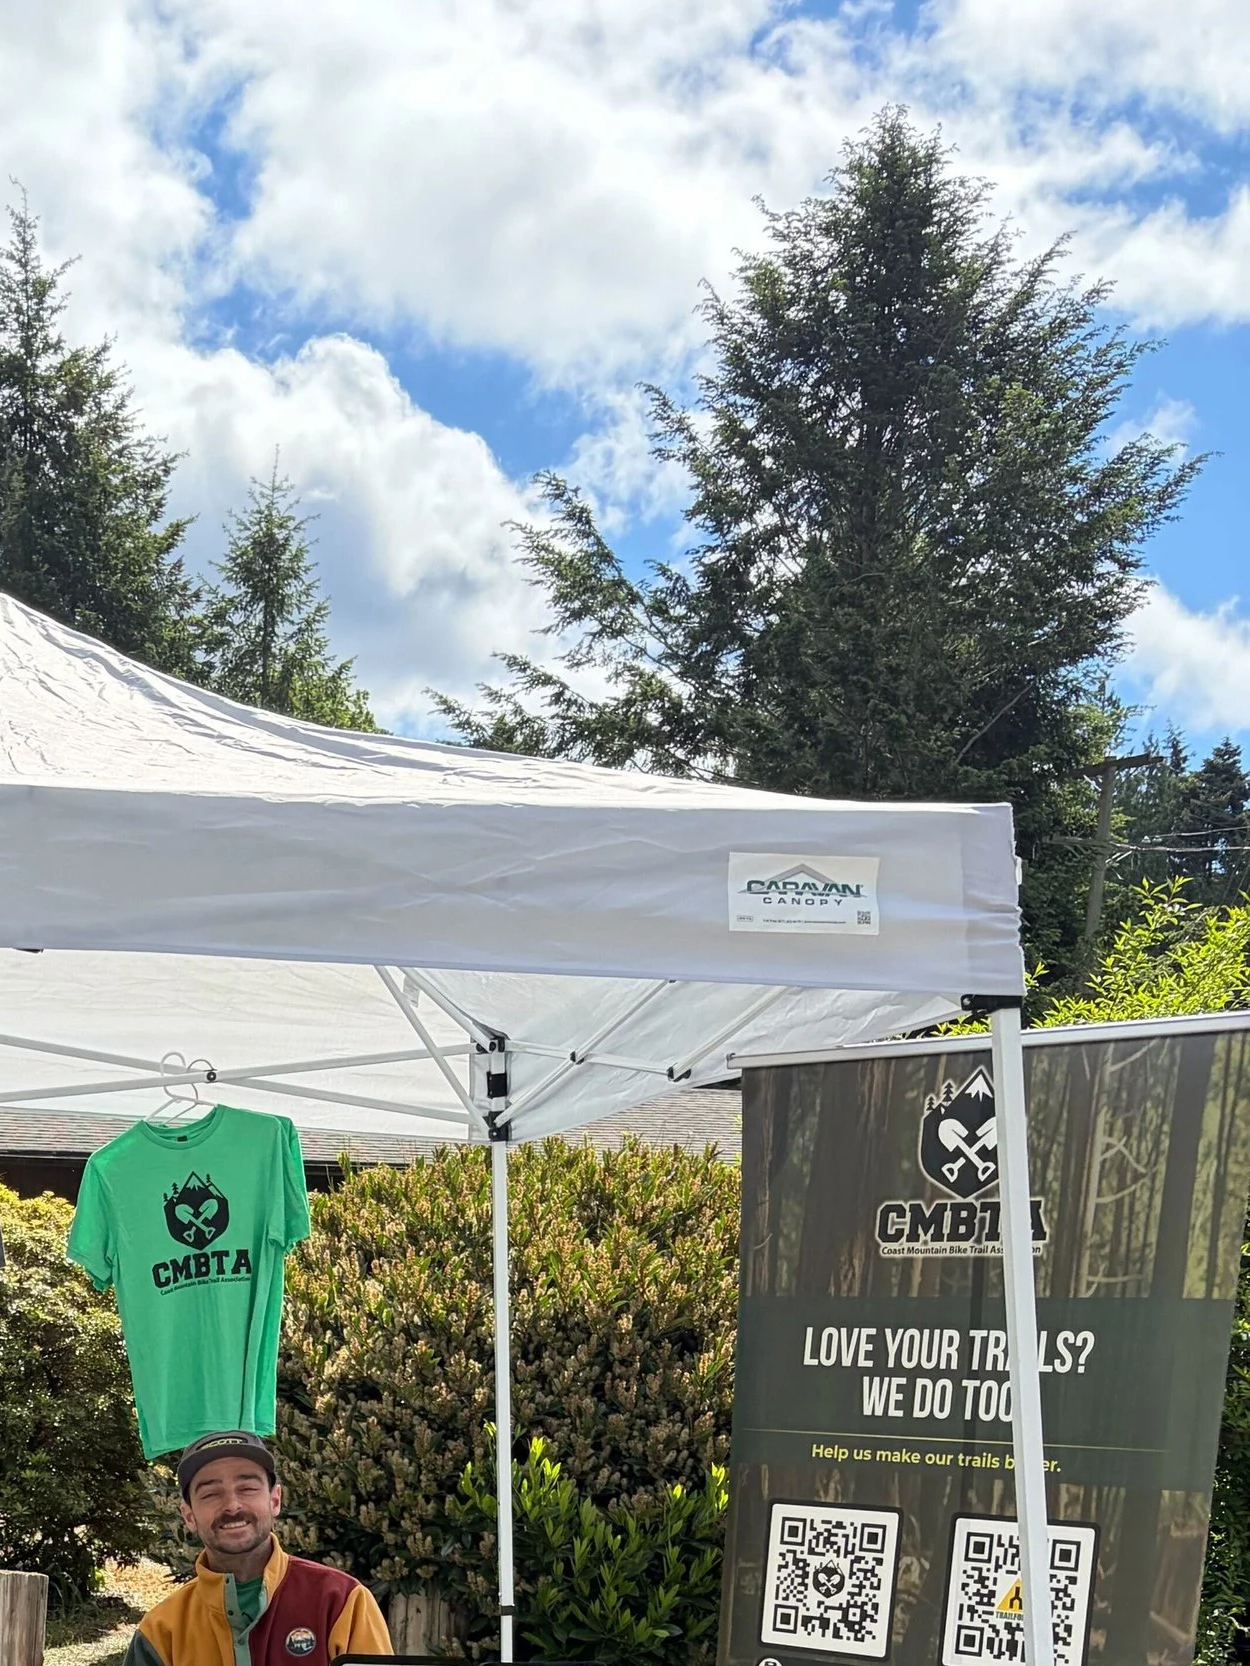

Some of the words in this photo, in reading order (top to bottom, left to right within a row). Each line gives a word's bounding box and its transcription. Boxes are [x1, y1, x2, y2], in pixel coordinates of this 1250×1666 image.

[746, 879, 862, 898] CARAVAN
[763, 897, 843, 906] CANOPY
[881, 1246, 905, 1255] Coast
[906, 1246, 947, 1255] Mountain
[949, 1245, 968, 1254] Bike
[969, 1245, 989, 1254] Trail
[151, 1249, 252, 1289] CMBTA
[803, 1327, 877, 1368] LOVE
[885, 1328, 960, 1371] YOUR
[969, 1329, 1095, 1374] TRLS?
[862, 1376, 907, 1417] WE
[912, 1377, 952, 1420] DO
[812, 1444, 849, 1462] Help
[853, 1448, 872, 1460] us
[876, 1448, 921, 1464] make
[925, 1453, 952, 1466] our
[957, 1452, 1000, 1470] trails
